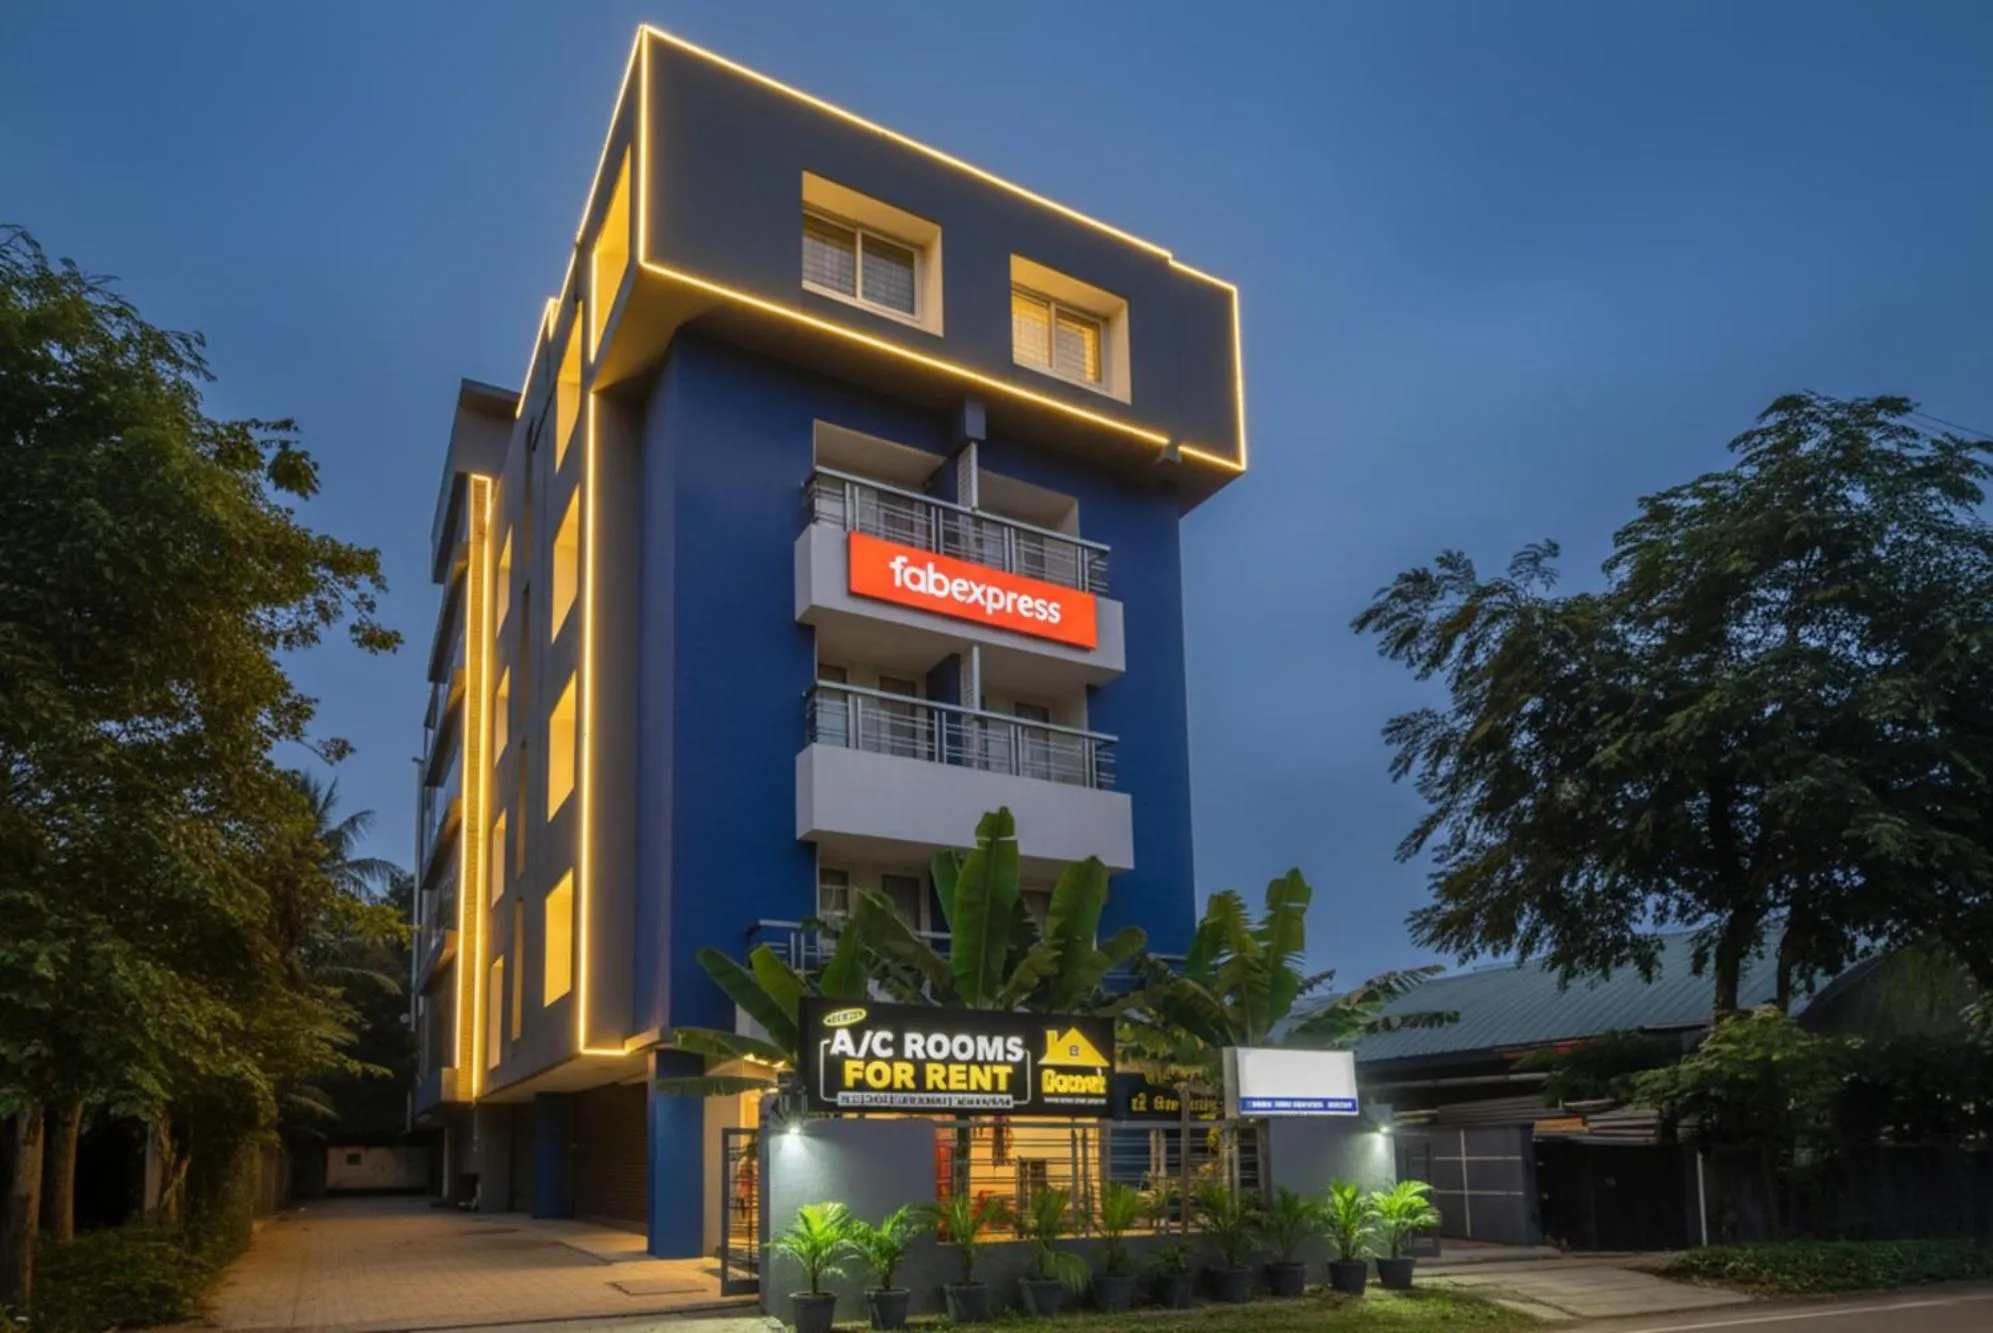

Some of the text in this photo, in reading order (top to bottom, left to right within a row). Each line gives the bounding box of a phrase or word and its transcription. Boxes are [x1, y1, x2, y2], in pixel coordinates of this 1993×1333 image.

[888, 555, 1062, 624] fabexpress
[830, 1028, 1025, 1062] A/C ROOMS
[844, 1060, 916, 1089] FOR
[925, 1061, 1013, 1091] RENT
